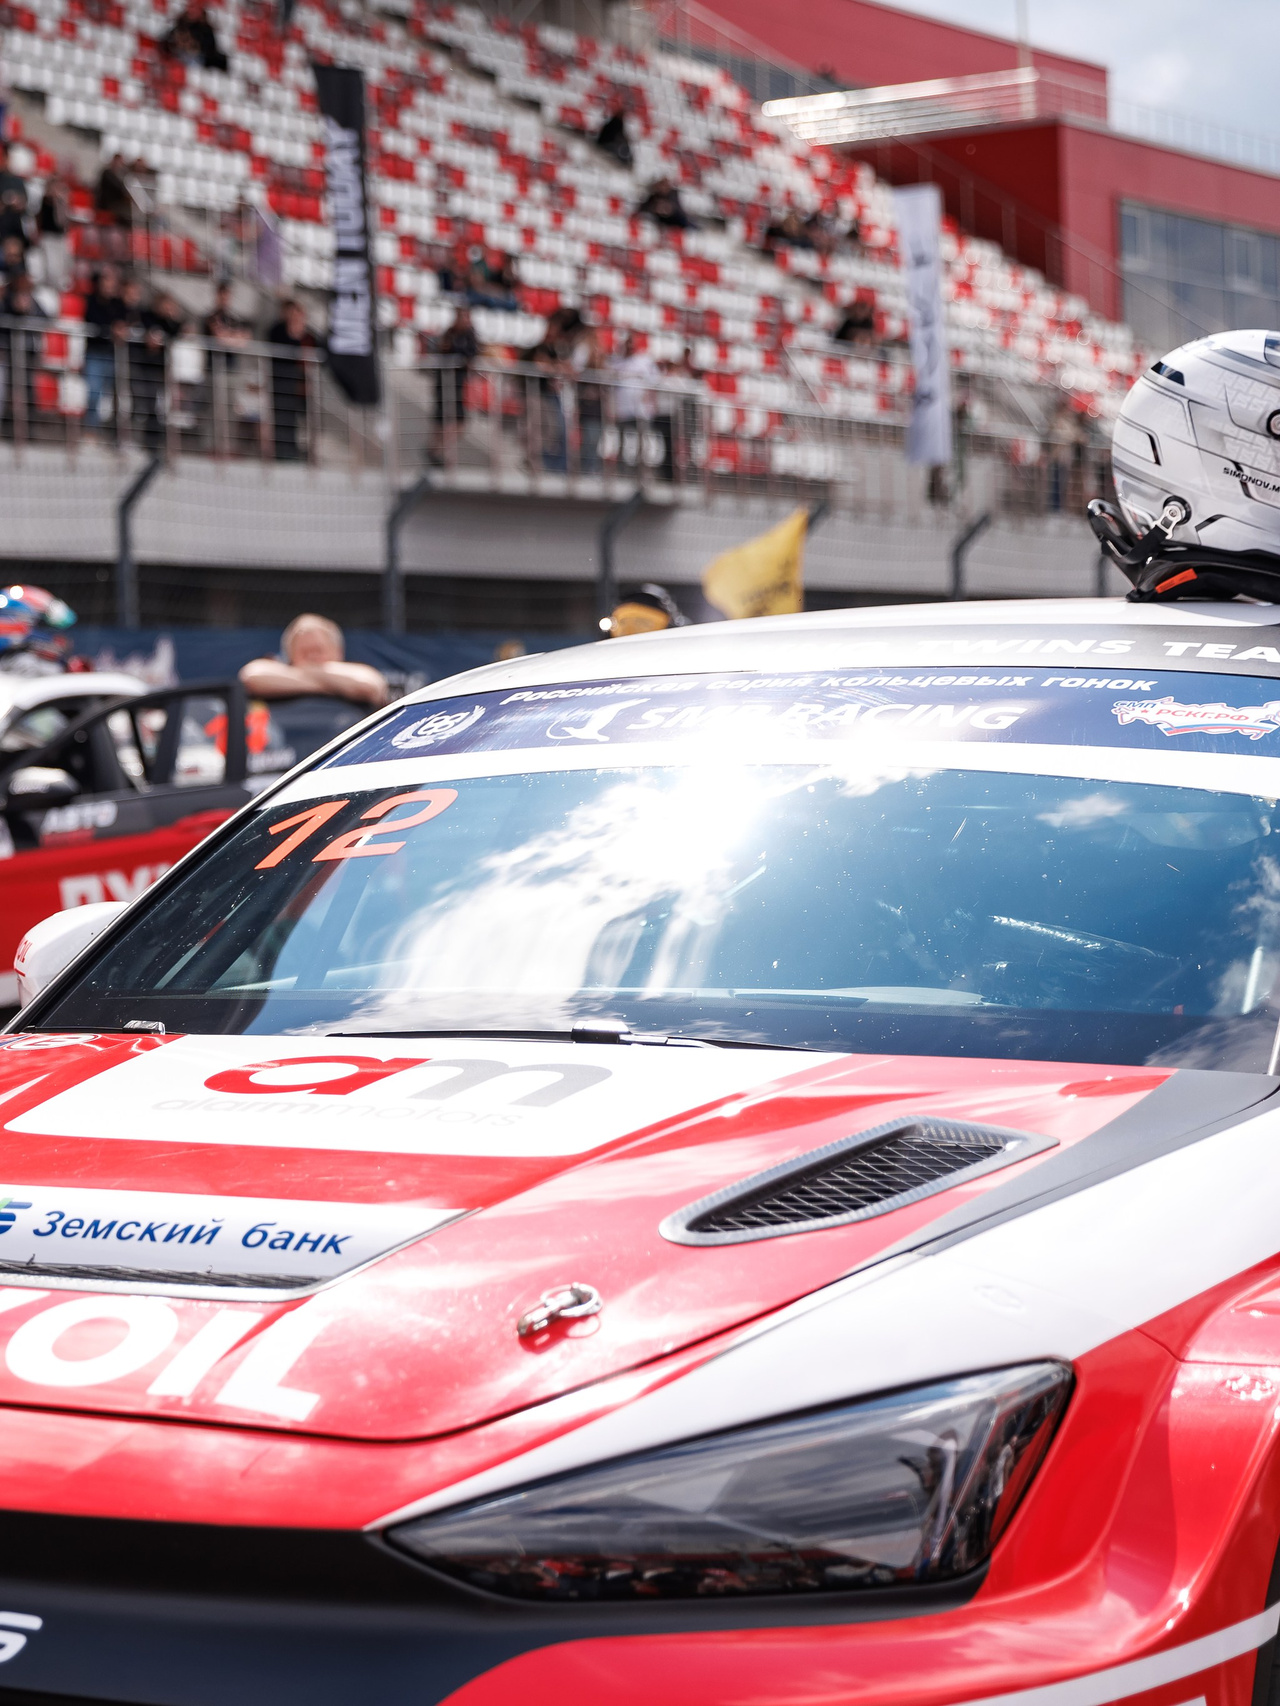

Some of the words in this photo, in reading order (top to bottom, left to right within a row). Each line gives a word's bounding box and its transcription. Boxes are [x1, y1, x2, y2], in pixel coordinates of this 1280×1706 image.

[1162, 641, 1280, 664] TEA
[499, 677, 697, 706] Российская
[821, 674, 1033, 691] кольцевых
[1040, 676, 1159, 692] гонок
[254, 788, 459, 870] 12
[32, 1208, 224, 1247] Земский
[240, 1222, 354, 1256] банк
